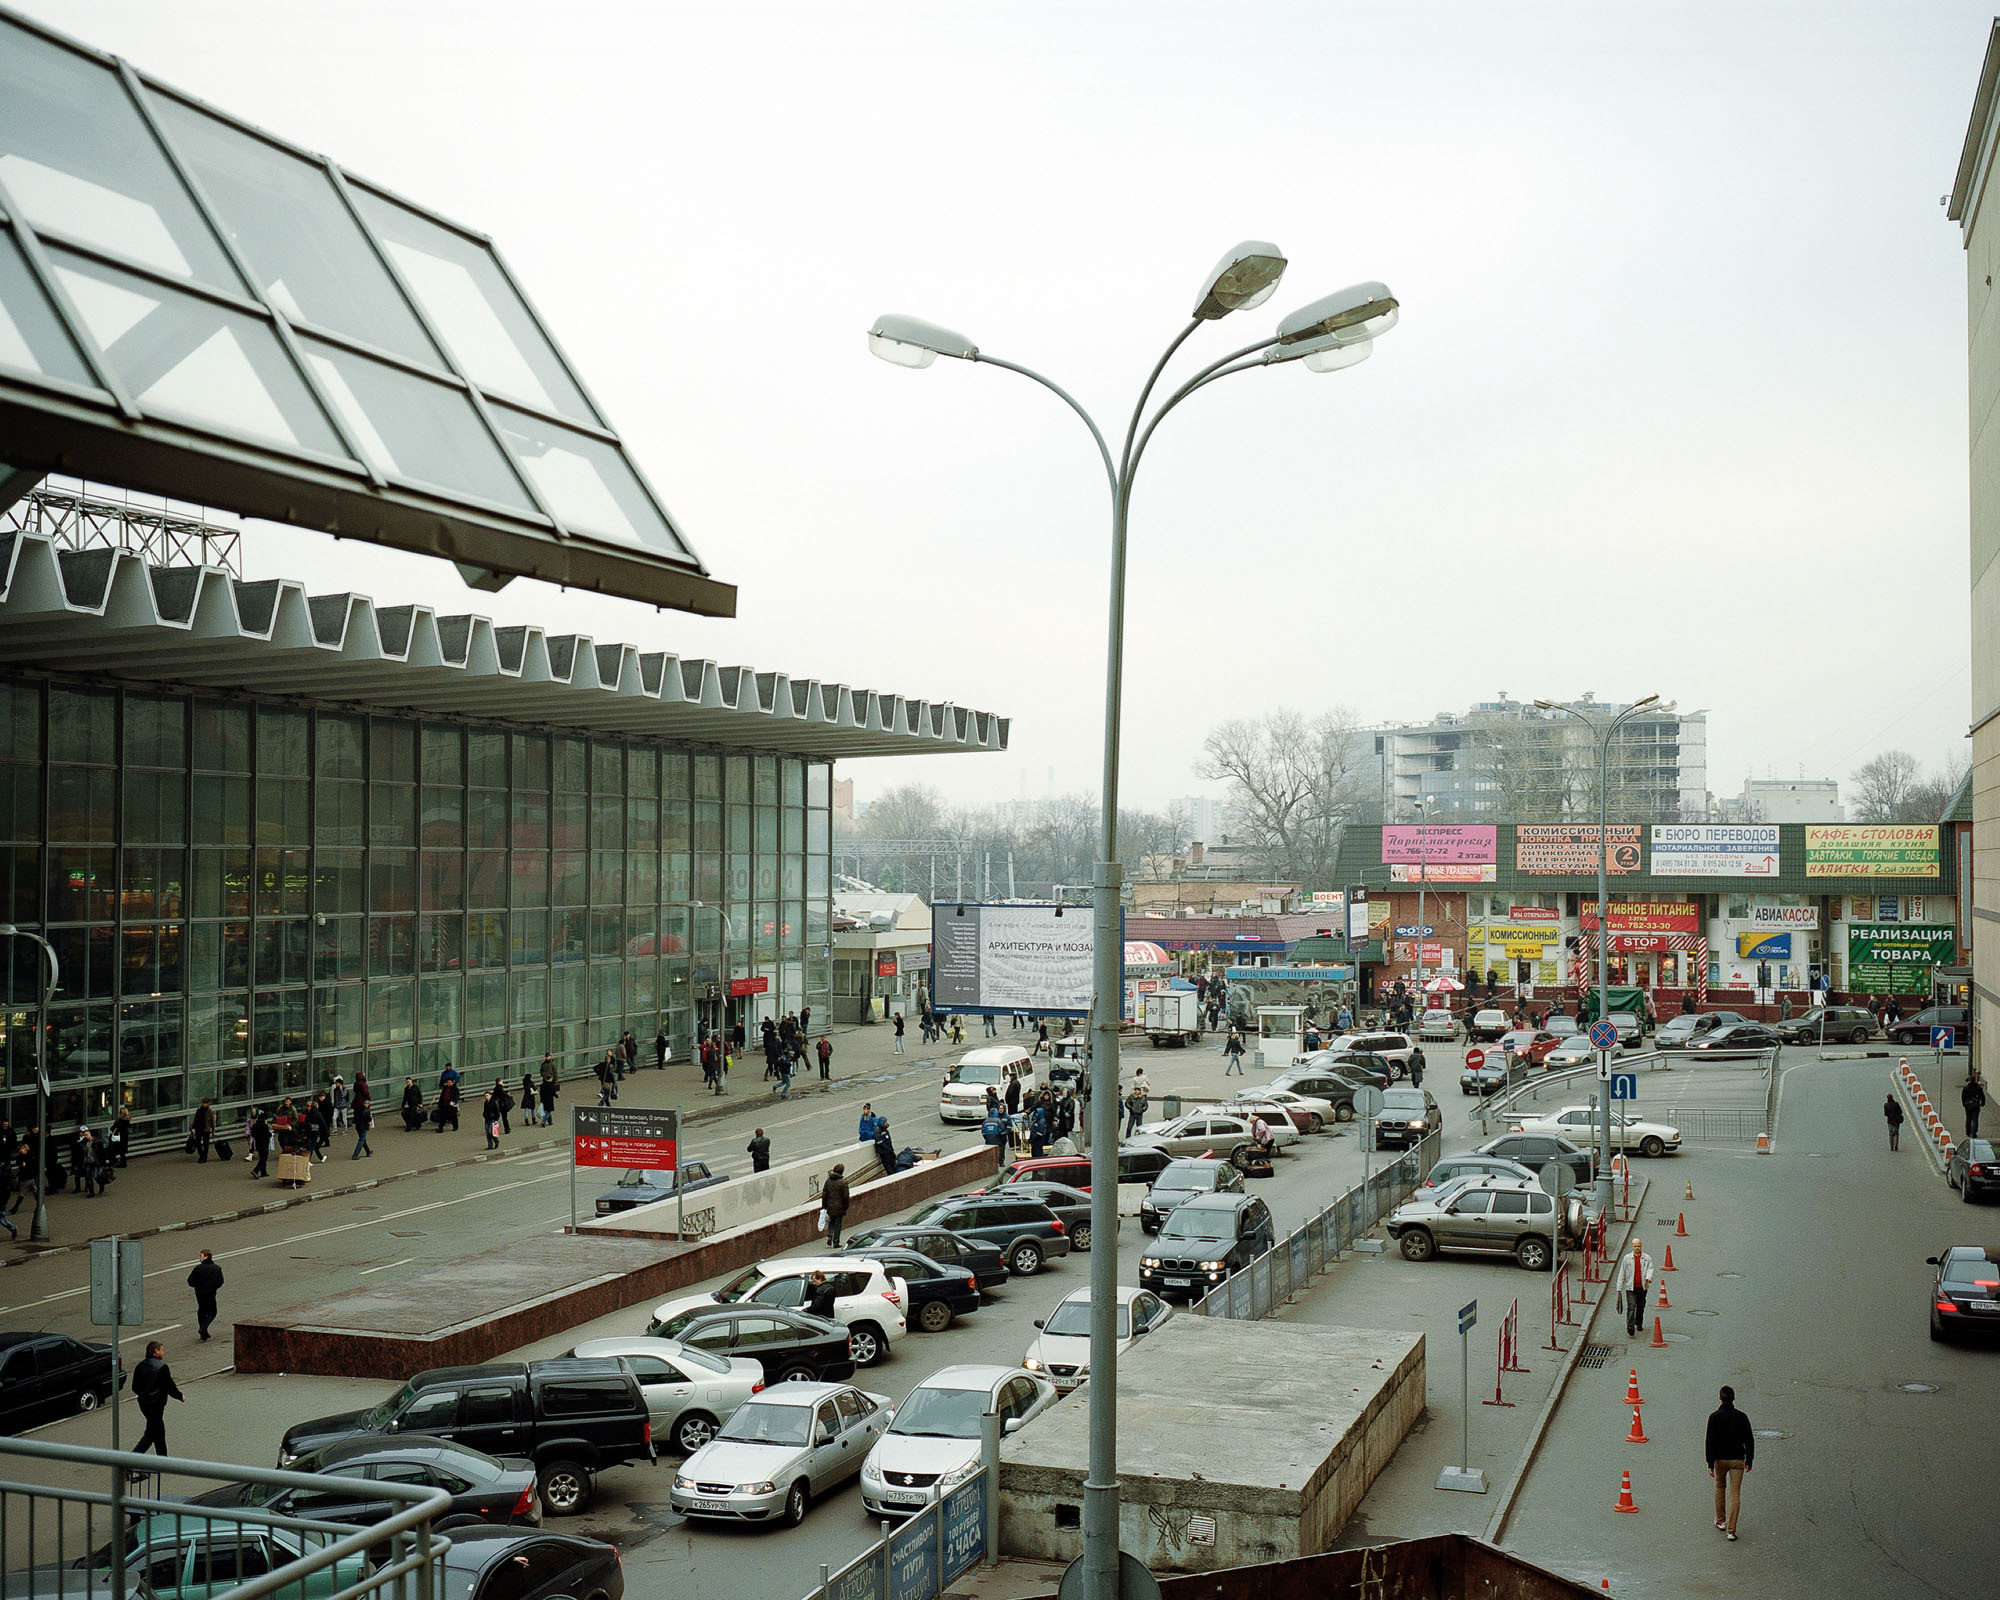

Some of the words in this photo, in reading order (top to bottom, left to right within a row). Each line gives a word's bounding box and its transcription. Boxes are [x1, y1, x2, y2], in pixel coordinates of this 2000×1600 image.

[1523, 826, 1635, 835] КОМИССИОННЫЙ
[1666, 828, 1700, 840] БЮРО
[1706, 828, 1776, 842] ПЕРЕВОДОВ
[1810, 828, 1850, 840] КАФЕ
[1861, 828, 1934, 840] СТОЛОВАЯ
[1622, 847, 1633, 860] 2
[1809, 850, 1854, 860] ЗАВТРАКИ,
[1862, 850, 1900, 860] ГОРЯЧИЕ
[1904, 850, 1935, 861] ОБЕДЫ
[1408, 865, 1445, 874] ЮВЕИРНЫЕ
[1745, 862, 1752, 870] 2
[1809, 864, 1870, 873] НАПИТКИ
[1649, 904, 1696, 916] ПИТАНИЕ
[1755, 908, 1816, 922] АВИАКАССА
[1490, 929, 1558, 940] КОМИССИОННЫЙ
[1850, 930, 1953, 942] РЕАЛИЗАЦИЯ
[988, 942, 1054, 950] АРХИТЕКТУРА
[1624, 938, 1658, 947] STOP
[1870, 950, 1932, 960] ТОВАРА
[960, 1508, 980, 1534] РУБЛЕЙ
[891, 1523, 934, 1566] СЧАСТЛИВОГО
[947, 1543, 954, 1565] 2
[956, 1522, 981, 1556] ЧАСА
[902, 1552, 925, 1582] ПУТИ
